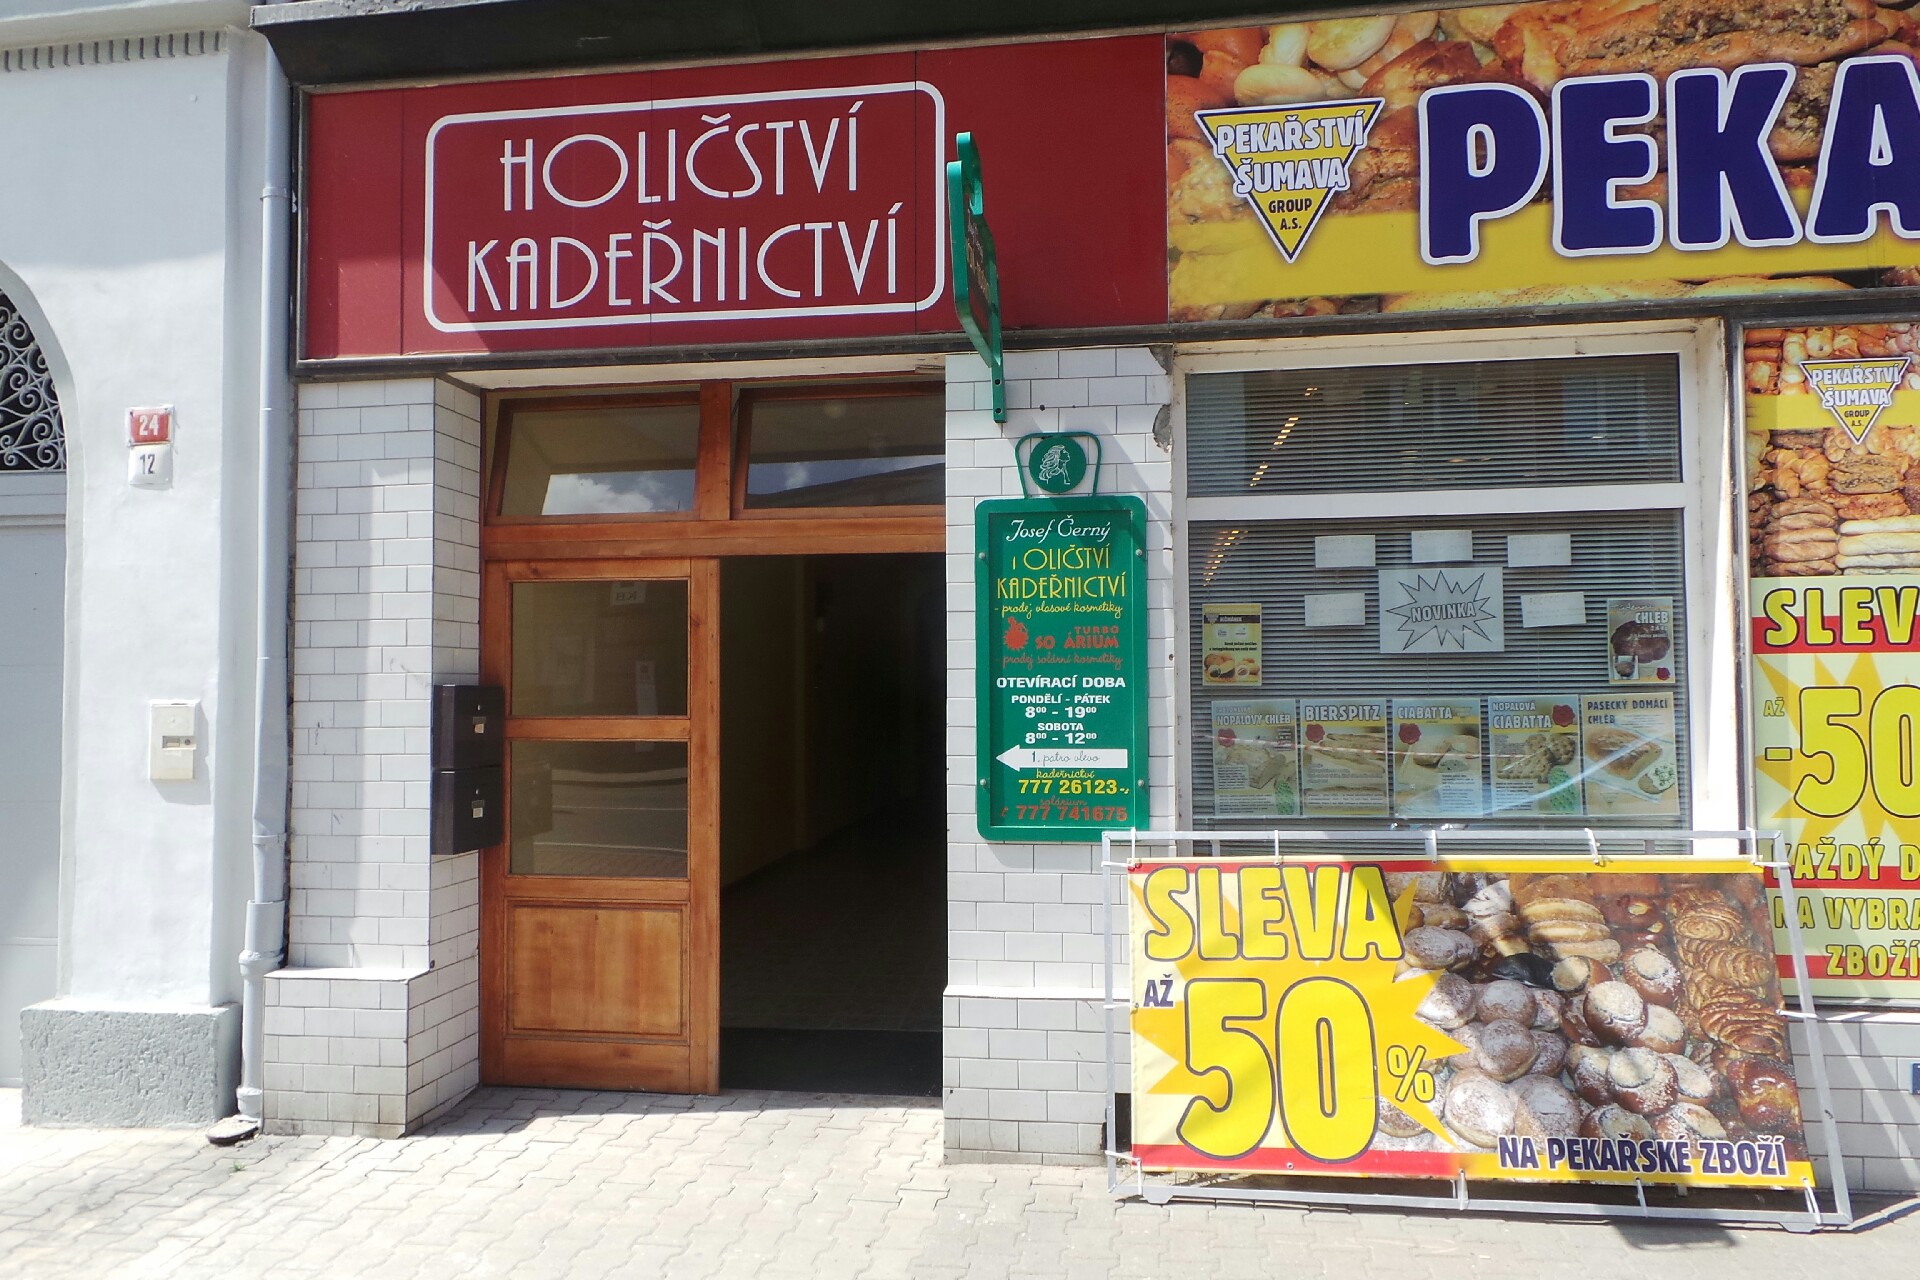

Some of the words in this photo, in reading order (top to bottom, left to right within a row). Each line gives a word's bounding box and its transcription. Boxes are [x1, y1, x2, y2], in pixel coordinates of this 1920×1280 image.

[1216, 109, 1365, 155] PEKAŘSTVÍ
[499, 100, 864, 211] HOLIČSTVÍ
[1418, 54, 1920, 266] PEKA
[1236, 157, 1347, 195] ŠUMAVA
[1268, 198, 1312, 214] GROUP
[1279, 217, 1302, 230] A.S.
[467, 202, 903, 312] KADEŘNICTVÍ
[1812, 364, 1899, 386] PEKAŘSTVÍ
[1824, 387, 1889, 407] ŠUMAVA
[1844, 410, 1870, 418] GROUP
[139, 414, 159, 436] 24
[139, 454, 155, 474] 12
[1006, 519, 1055, 544] Josef
[1058, 514, 1111, 543] Černý
[997, 571, 1127, 599] KADEŘNICTVÍ
[1002, 602, 1032, 619] prodej
[1036, 600, 1071, 613] vlasové
[1073, 601, 1123, 619] kosmetiky
[1411, 601, 1476, 623] NOVINKA
[1074, 625, 1120, 635] TURBO
[1035, 632, 1120, 649] SOÁRIUM
[1003, 652, 1034, 670] prodej
[1037, 651, 1072, 664] solární
[1074, 651, 1123, 670] kosmetiky
[996, 675, 1079, 688] OTEVÍRACÍ
[1083, 677, 1126, 688] DOBA
[1011, 693, 1063, 704] PONDĚLÍ
[1074, 693, 1110, 704] PÁTEK
[1587, 699, 1628, 710] PASECKÝ
[1763, 697, 1785, 717] AŽ
[1265, 712, 1291, 724] CHLÉB
[1305, 705, 1381, 721] BIERSPITZ
[1398, 706, 1453, 719] CIABATTA
[1493, 715, 1552, 729] CIABATTA
[1037, 722, 1084, 731] SOBOTA
[1031, 751, 1041, 763] 1.
[1042, 751, 1071, 767] patro
[1073, 751, 1100, 762] vlevo
[1036, 768, 1095, 779] kadeřnictví
[1018, 779, 1053, 794] 777
[1059, 779, 1130, 794] 26123
[1040, 795, 1087, 806] solárium
[1016, 805, 1051, 820] 777
[1058, 805, 1128, 821] 741675
[1143, 864, 1405, 961] SLEVA
[1826, 940, 1920, 977] ZBOŽÍ
[1143, 973, 1174, 1007] AŽ
[1176, 976, 1379, 1164] 50
[1386, 1045, 1435, 1103] %
[1498, 1136, 1539, 1170] NA
[1547, 1132, 1693, 1174] PEKAŘSKÉ
[1699, 1134, 1788, 1177] ZBOŽÍ
